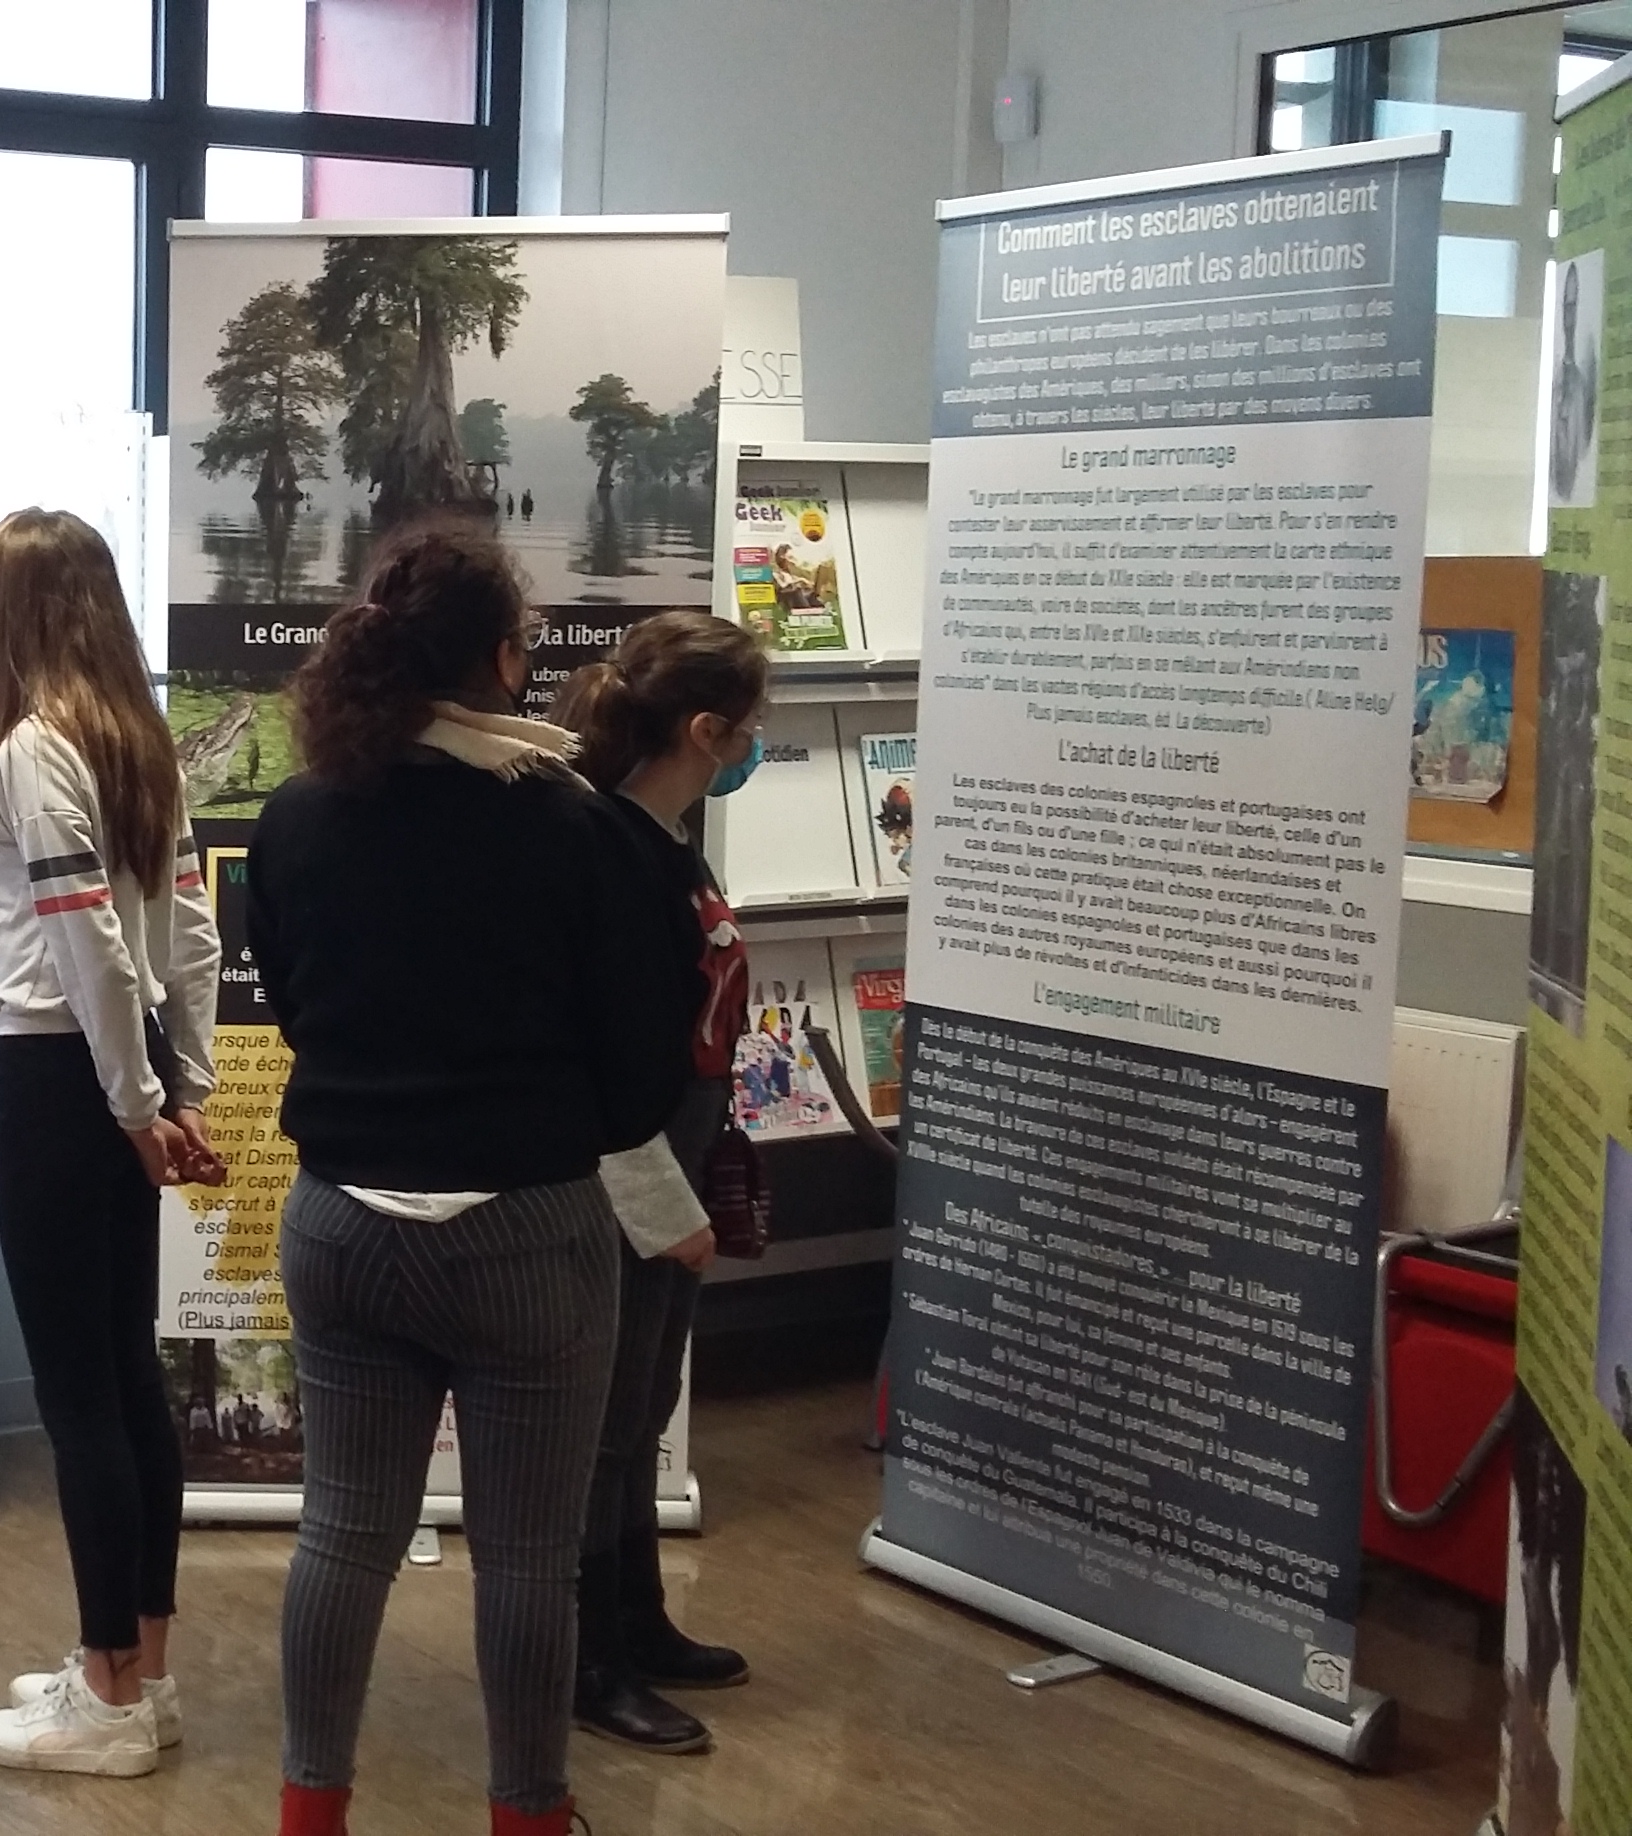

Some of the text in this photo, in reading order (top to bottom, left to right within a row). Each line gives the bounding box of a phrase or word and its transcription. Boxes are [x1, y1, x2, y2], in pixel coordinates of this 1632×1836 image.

[998, 180, 1379, 254] Comment les esclaves obtenaient
[1002, 239, 1365, 303] leur liberté avant les abolitions
[1061, 445, 1236, 473] Le grand marronnage
[735, 502, 783, 521] Geek
[1279, 510, 1397, 530] Pour rendre
[244, 623, 267, 644] Le
[544, 623, 633, 646] la libert
[1059, 739, 1220, 773] L'achat de la liberté
[953, 773, 1366, 825] Les esclaves des colonies espagnoles et portugaises ont
[221, 967, 260, 982] était
[864, 974, 905, 1003] Virg
[1034, 982, 1221, 1034] L'engagement militaire
[1281, 987, 1362, 1013] dernières.
[189, 1195, 260, 1212] s'accrut
[194, 1218, 275, 1236] esclaves
[205, 1242, 269, 1259] Dismal
[203, 1267, 282, 1281] esclaves
[178, 1312, 289, 1331] (Plus jamais
